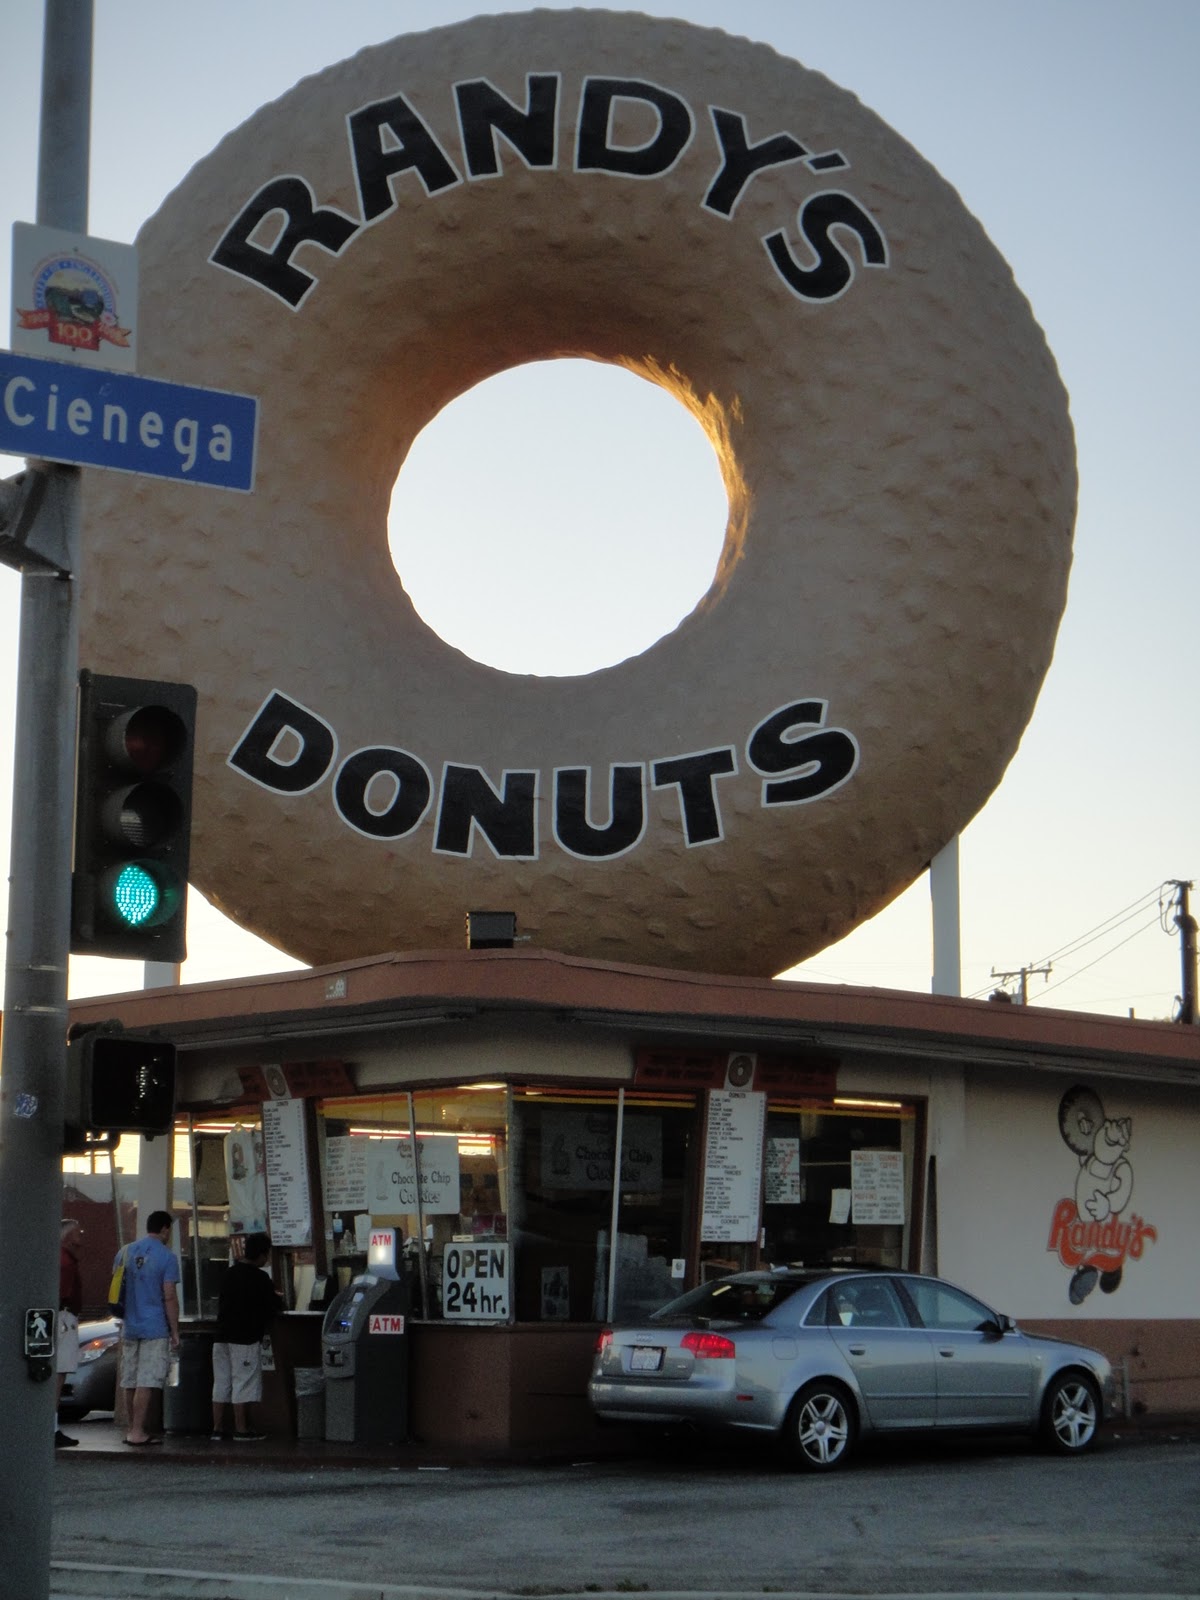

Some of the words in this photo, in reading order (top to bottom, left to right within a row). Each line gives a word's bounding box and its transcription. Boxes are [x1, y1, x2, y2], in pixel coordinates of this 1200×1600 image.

[207, 72, 888, 312] RANDY'S
[56, 322, 93, 342] 100
[4, 376, 233, 472] Cienega
[226, 688, 860, 862] DONUTS
[628, 1148, 653, 1165] Chip
[391, 1171, 428, 1185] Chocote
[431, 1170, 451, 1187] Chip
[371, 1234, 392, 1247] ATM
[1046, 1198, 1158, 1272] Randy's
[446, 1249, 505, 1279] OPEN
[372, 1316, 401, 1333] ATM
